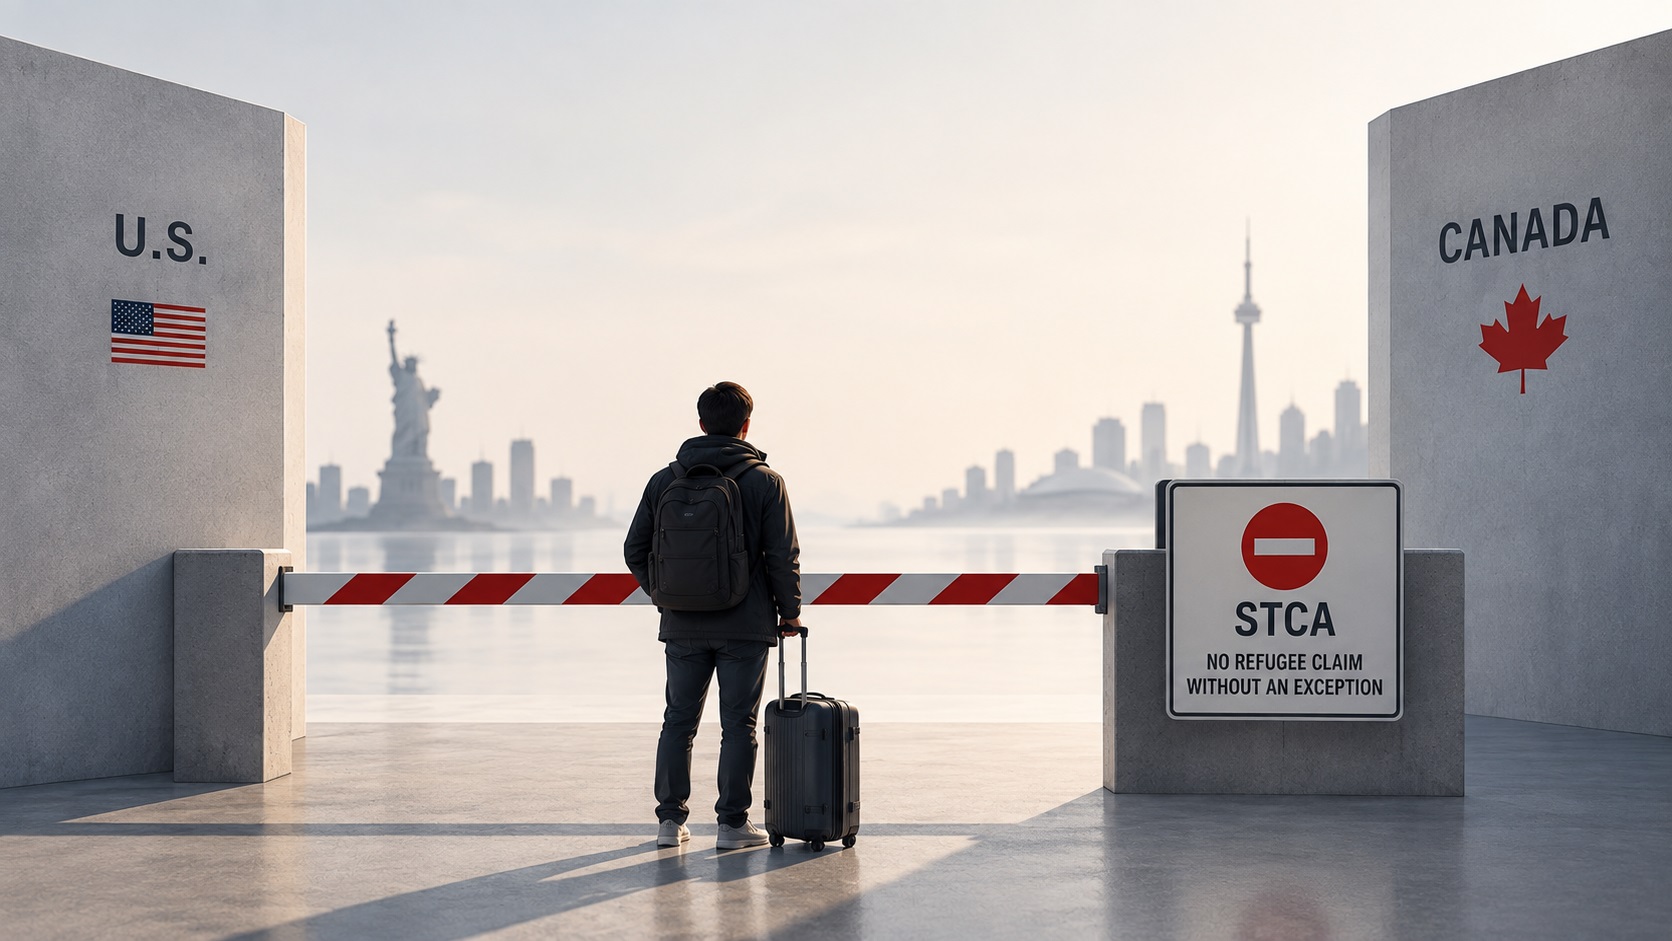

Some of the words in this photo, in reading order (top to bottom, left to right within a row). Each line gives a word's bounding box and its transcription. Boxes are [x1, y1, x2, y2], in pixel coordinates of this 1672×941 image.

[115, 213, 207, 266] U.S.
[1439, 196, 1611, 264] CANADA
[1235, 601, 1335, 637] STCA
[1206, 653, 1230, 671] NO
[1235, 653, 1307, 671] REFUGEE
[1311, 653, 1363, 671] CLAIM
[1187, 678, 1262, 696] WITHOUT
[1265, 678, 1289, 696] AN
[1293, 678, 1383, 696] EXCEPTION
